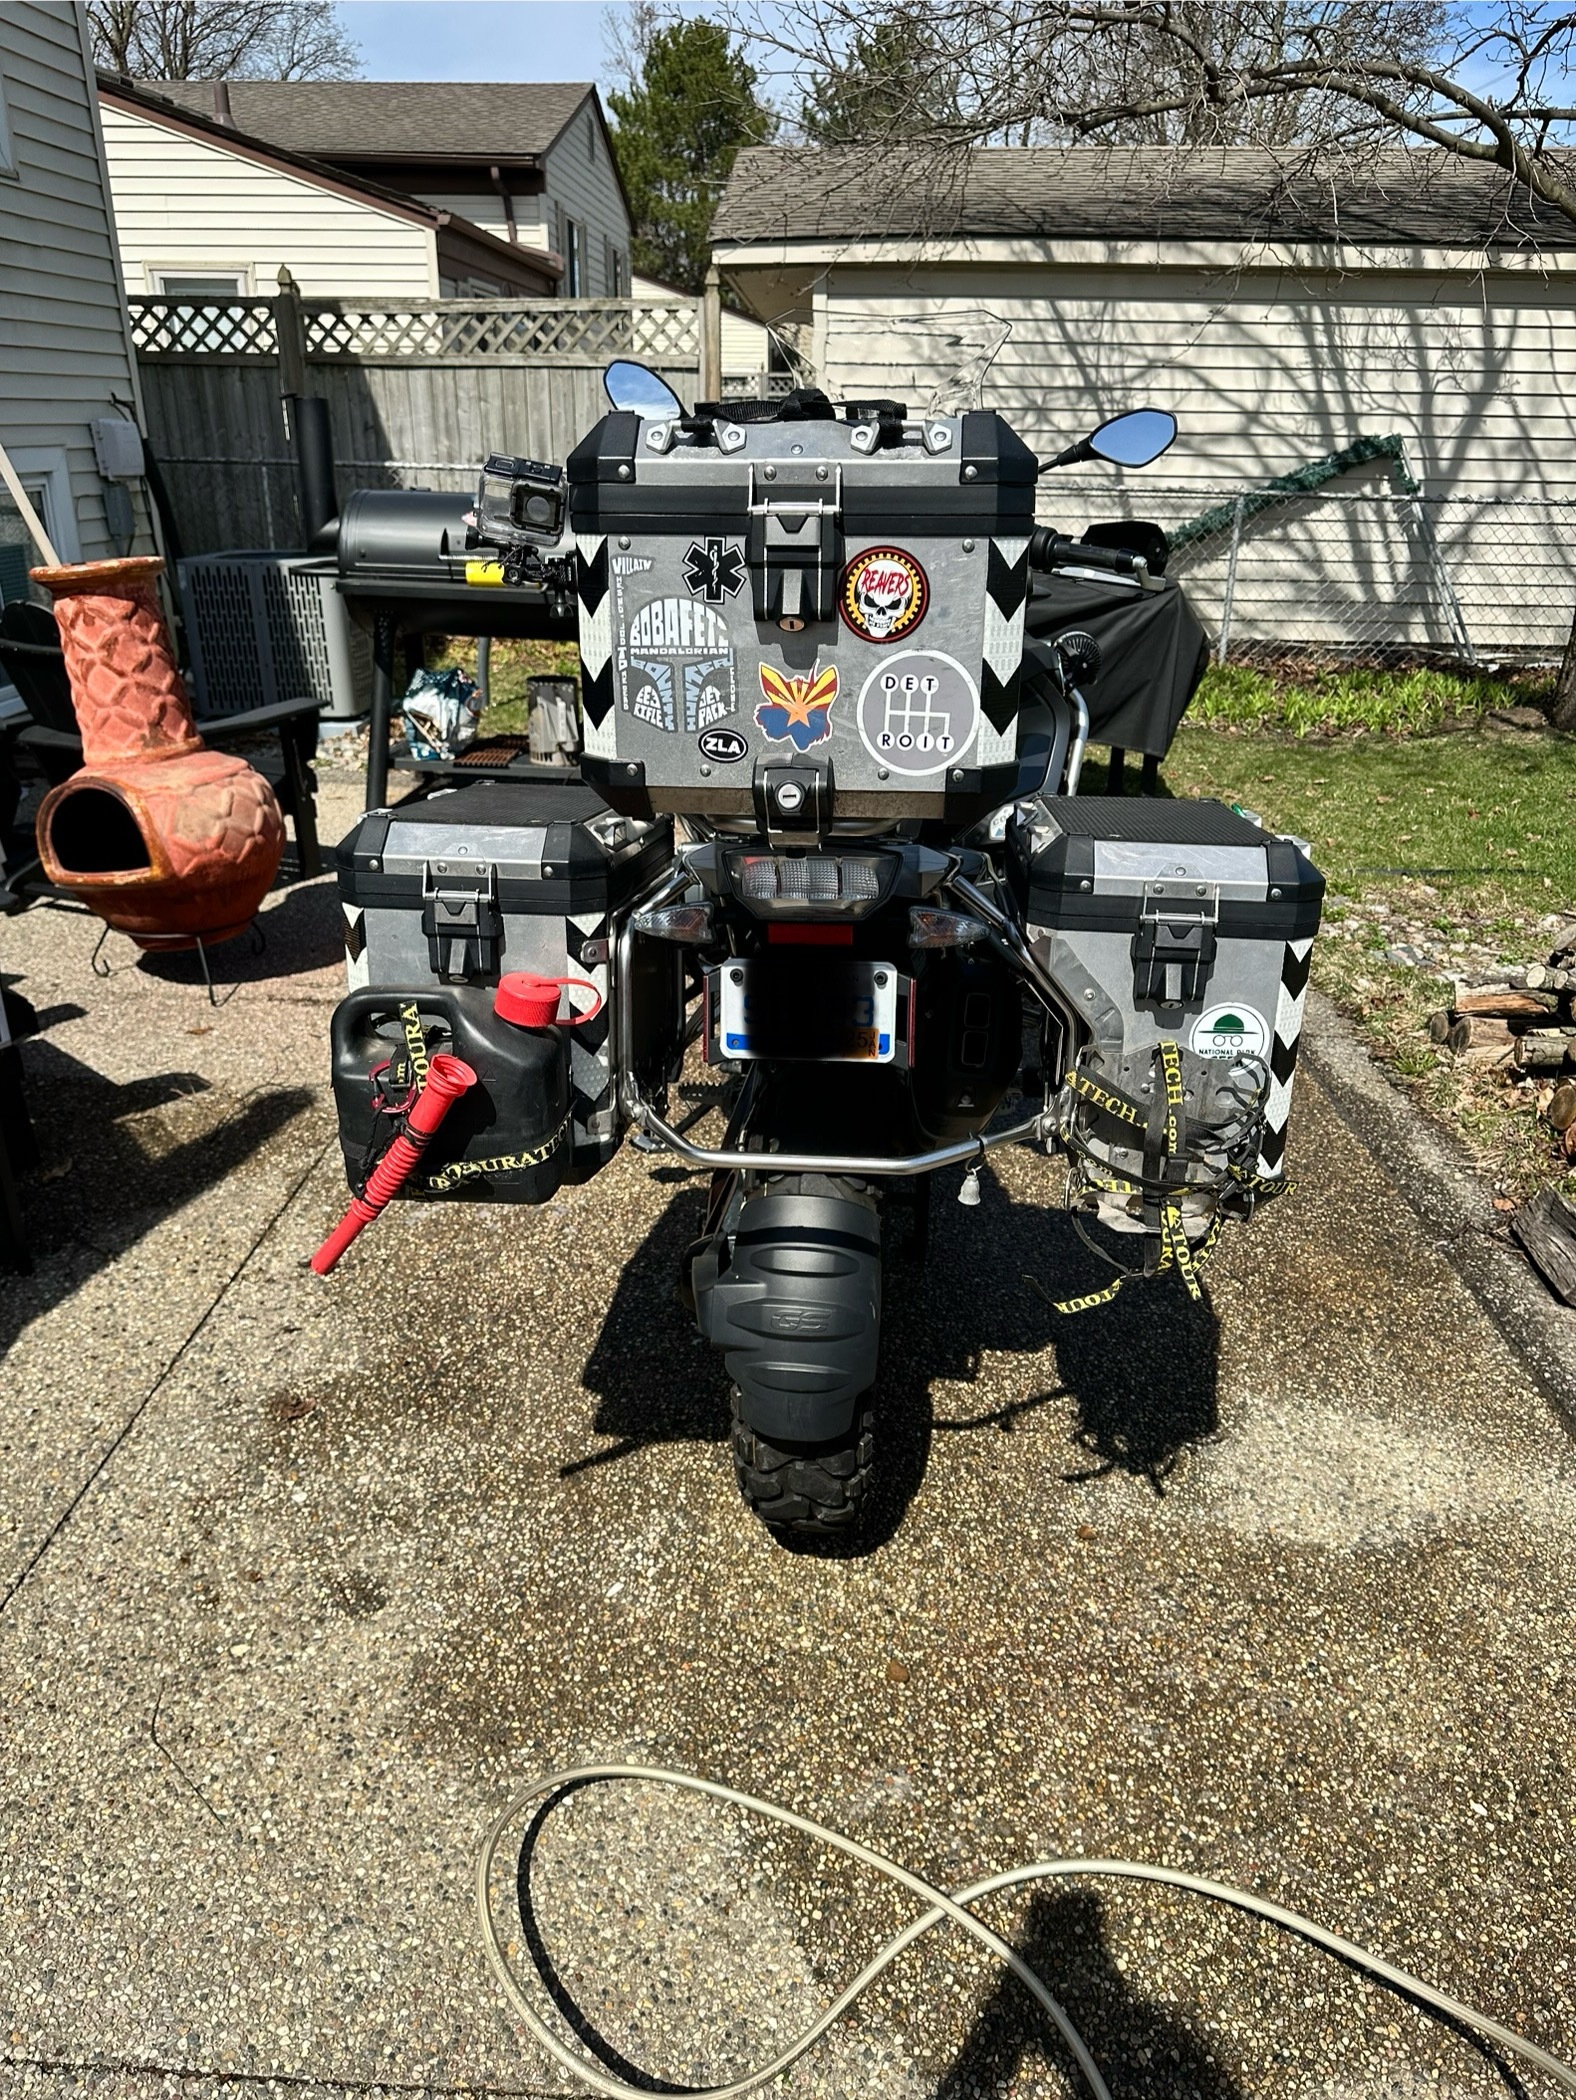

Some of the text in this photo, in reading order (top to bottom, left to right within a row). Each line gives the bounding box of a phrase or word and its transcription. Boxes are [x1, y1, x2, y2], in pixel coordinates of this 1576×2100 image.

[612, 557, 652, 575] VILLAIN
[861, 568, 911, 596] REAVERS
[630, 647, 728, 655] MANDALORIAN
[699, 685, 721, 708] JET
[633, 702, 664, 729] RIFLE
[698, 701, 728, 730] PACK
[705, 737, 741, 755] ZLA
[868, 1031, 876, 1057] JAN
[770, 1310, 832, 1332] GS
